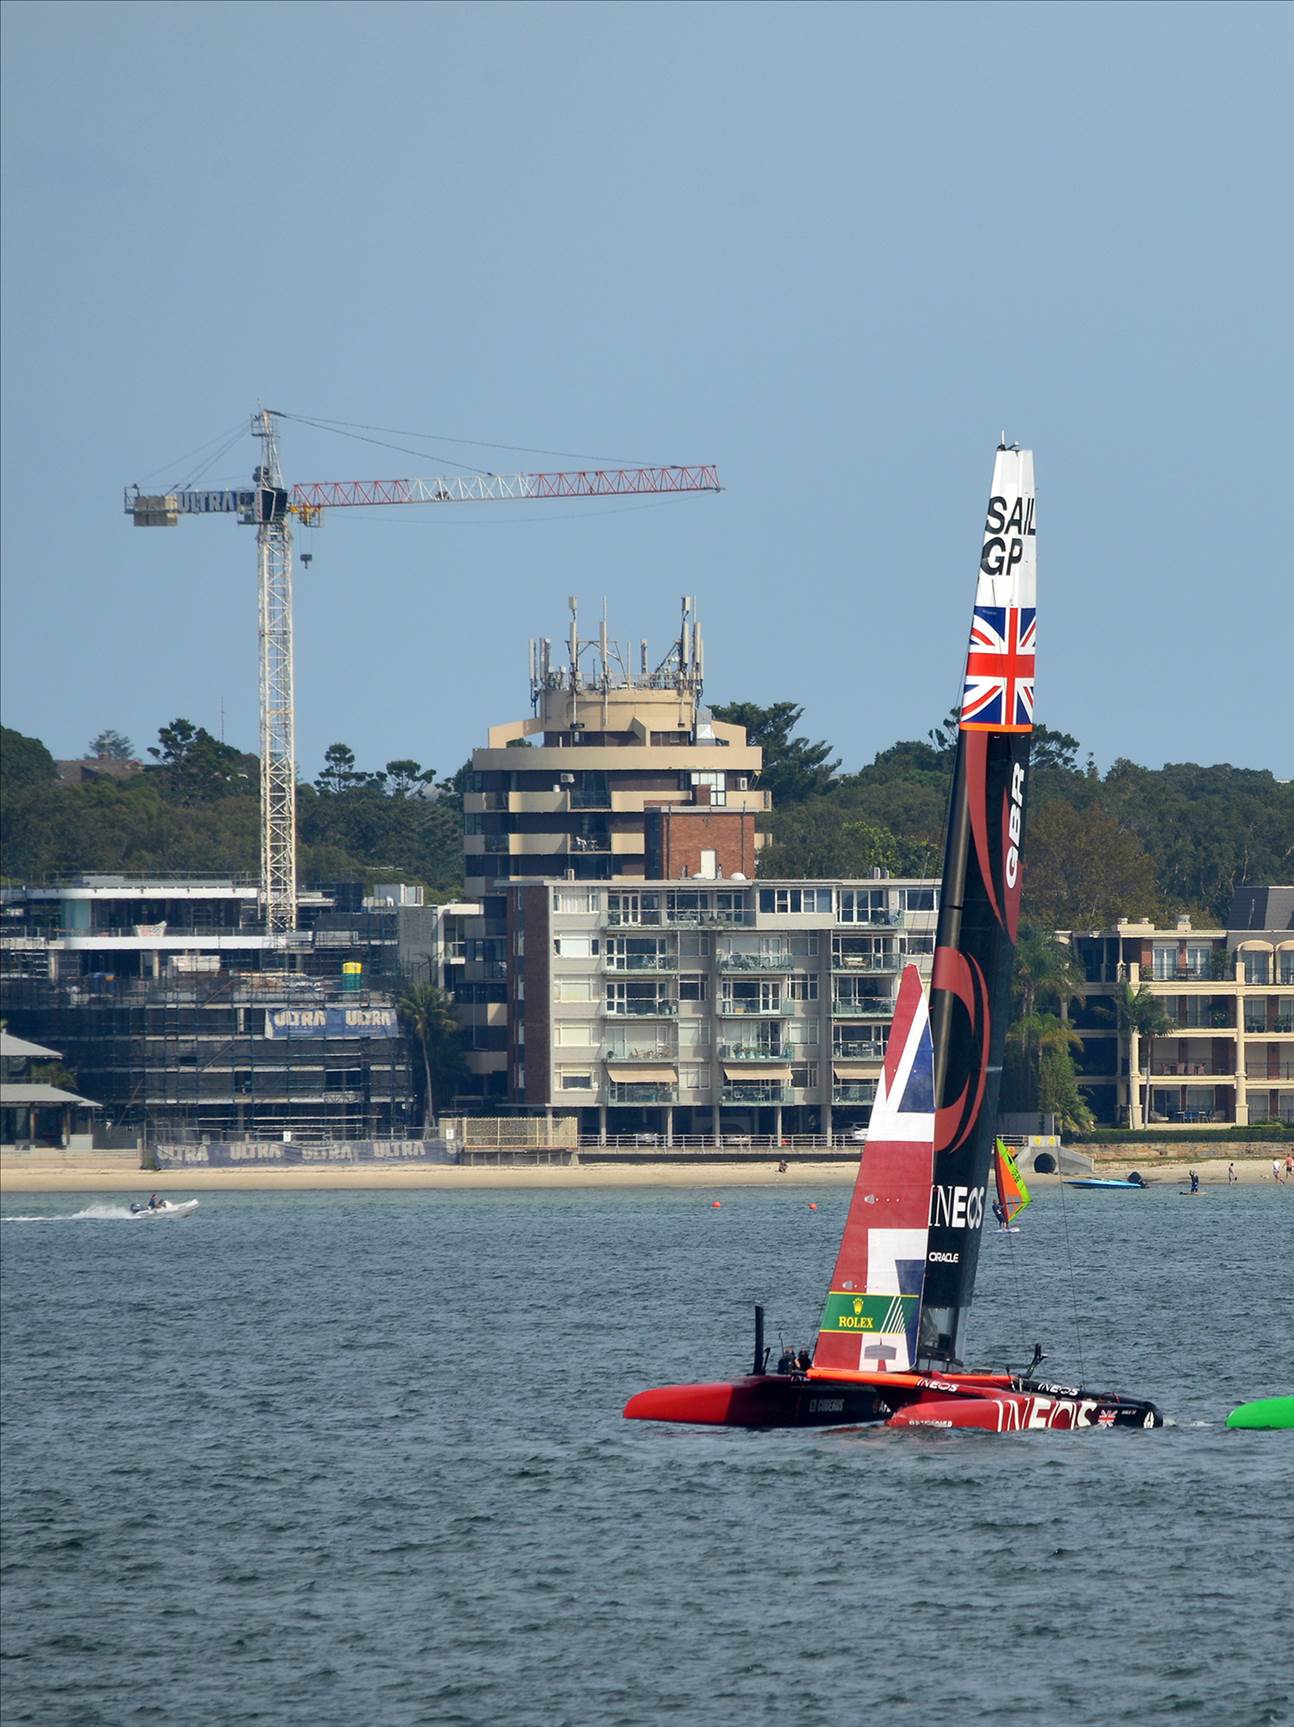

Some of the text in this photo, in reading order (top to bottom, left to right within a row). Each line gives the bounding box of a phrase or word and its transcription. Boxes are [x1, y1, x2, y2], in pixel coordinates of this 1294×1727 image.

[180, 492, 235, 514] ULTRA
[985, 496, 1036, 536] SAIL
[980, 536, 1023, 576] GP
[1006, 762, 1024, 889] GBR
[274, 1010, 391, 1026] ULTRA ULTRA
[230, 1141, 282, 1160] ULTRA
[373, 1141, 425, 1158] ULTRA
[928, 1185, 985, 1229] INEOS
[928, 1252, 959, 1263] ORACLE
[839, 1316, 873, 1328] ROLEX
[916, 1377, 959, 1392] INEOS
[1038, 1383, 1080, 1396] INEOS
[992, 1397, 1098, 1432] INEOS
